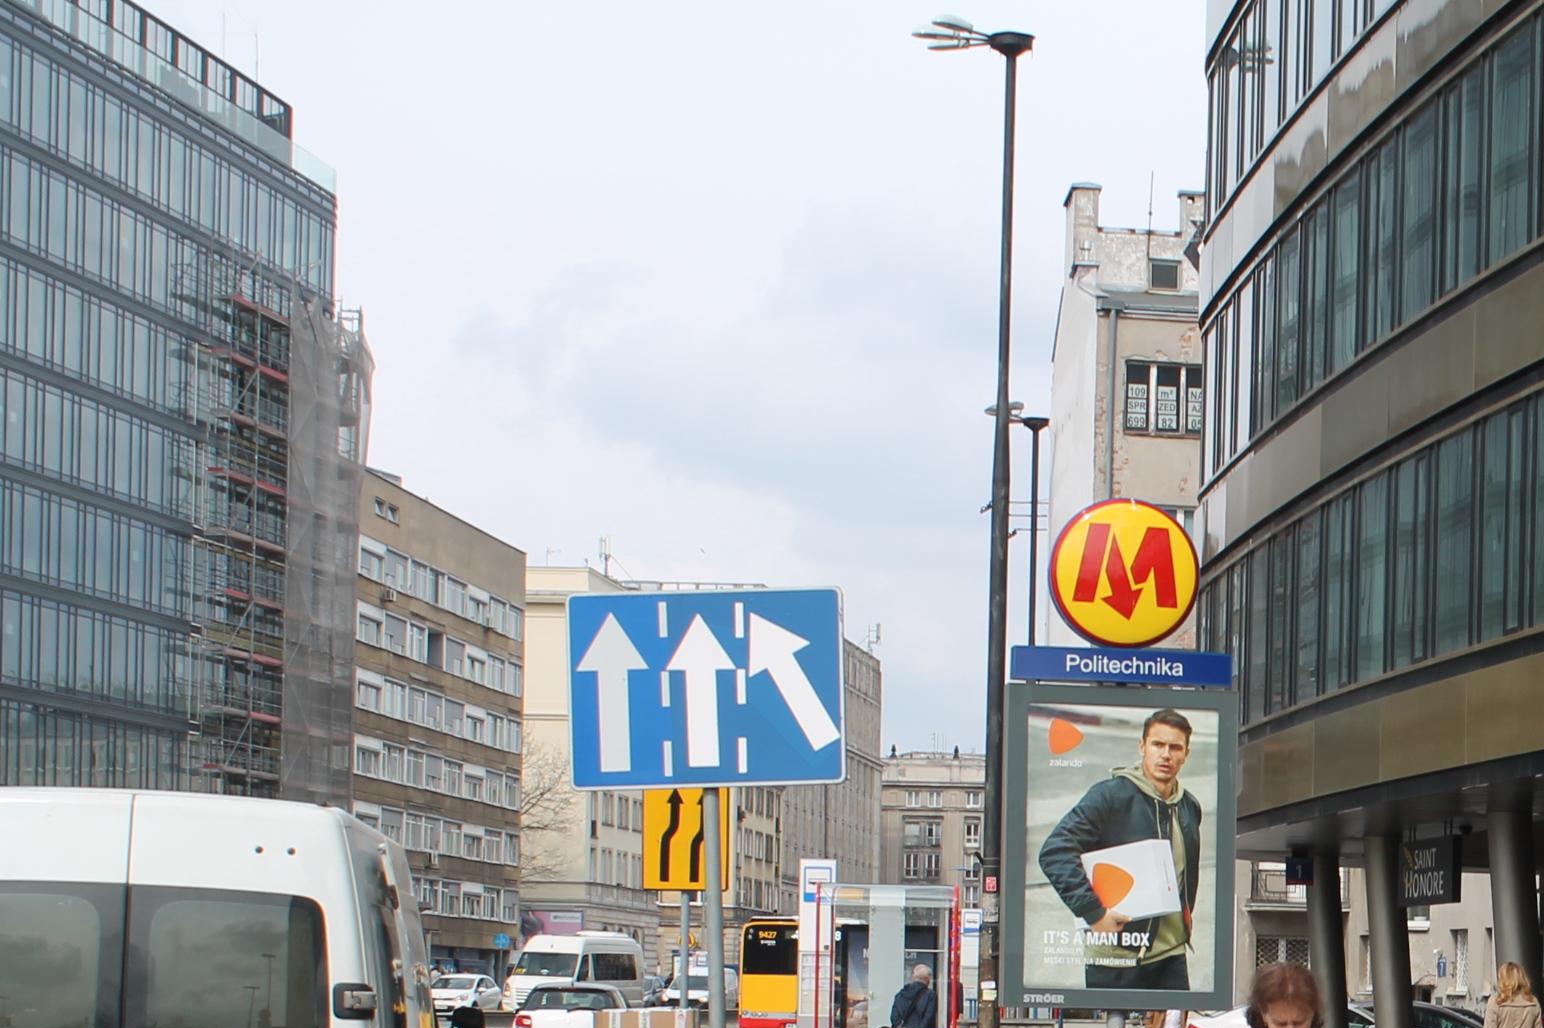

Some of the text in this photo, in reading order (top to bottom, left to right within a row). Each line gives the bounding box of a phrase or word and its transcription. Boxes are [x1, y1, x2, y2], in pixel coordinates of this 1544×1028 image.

[1065, 654, 1184, 677] Politechnika
[1049, 759, 1083, 768] zalando
[1414, 847, 1437, 870] SAINT
[1043, 930, 1150, 947] IT'S A MAN BOX
[1023, 993, 1064, 1003] STRÖER
